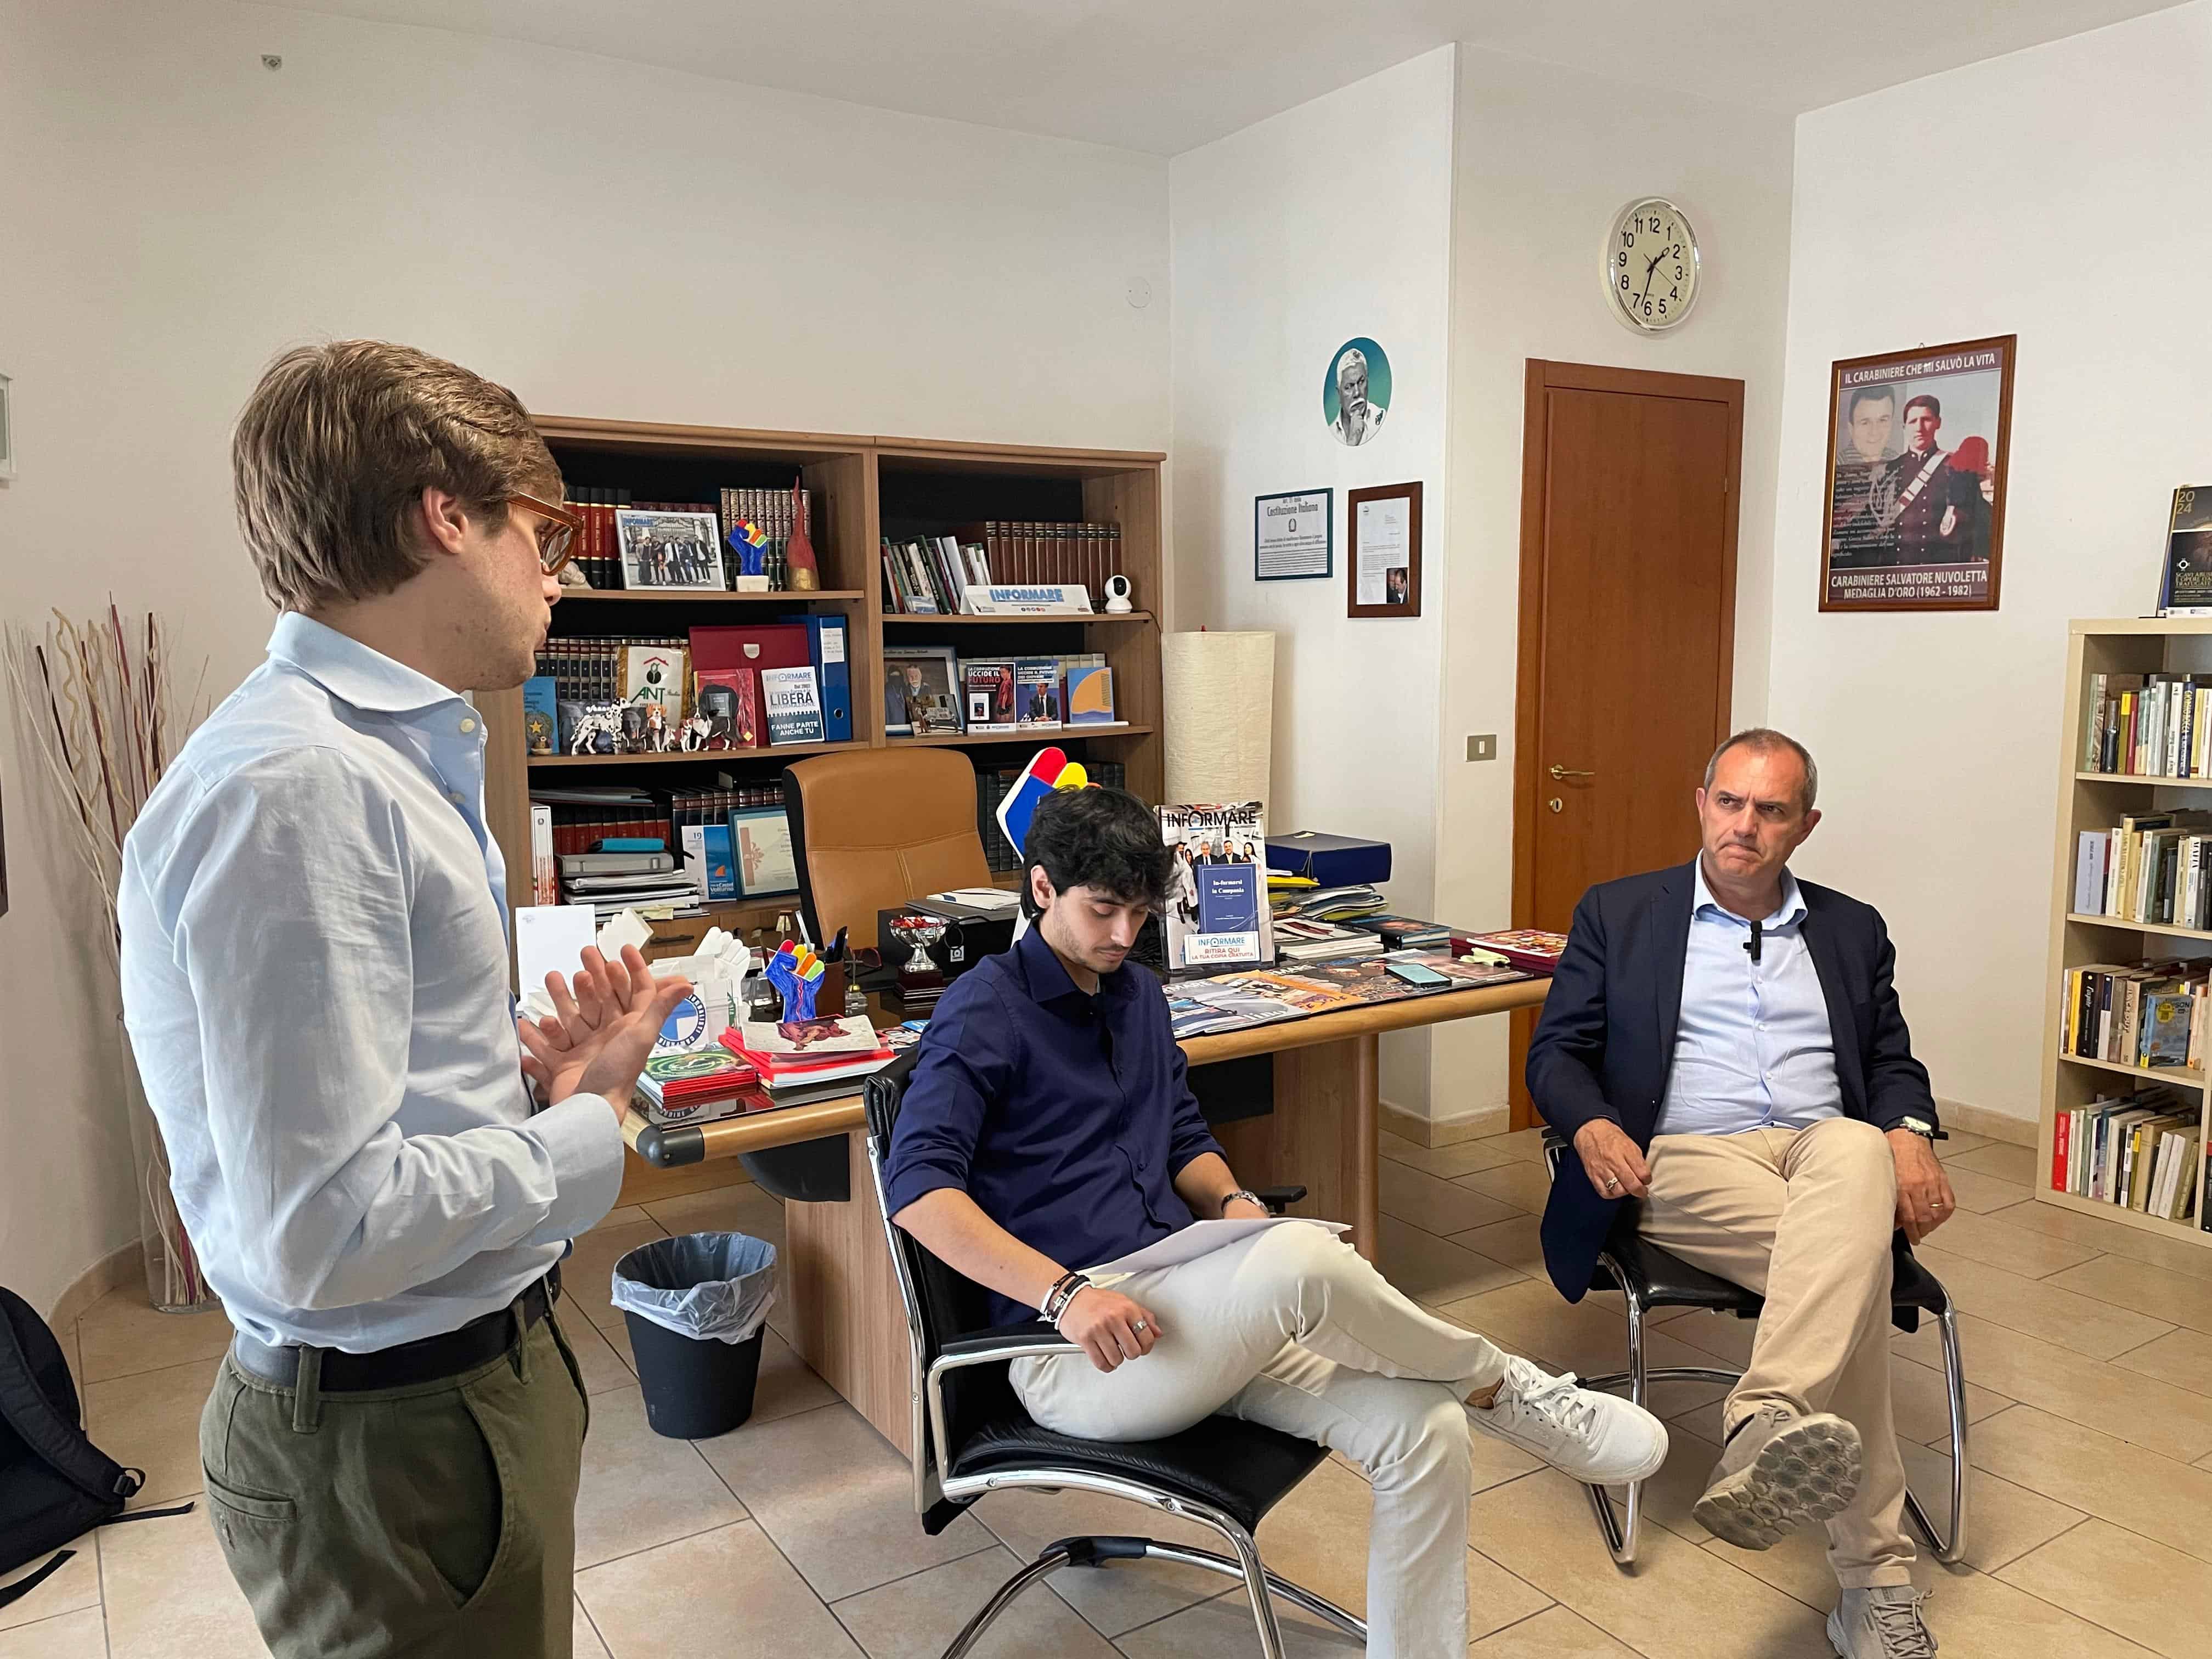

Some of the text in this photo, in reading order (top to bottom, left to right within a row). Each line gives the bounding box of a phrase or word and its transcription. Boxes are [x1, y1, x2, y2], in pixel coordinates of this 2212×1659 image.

[1635, 217, 1671, 241] 11 12 1
[1622, 231, 1680, 259] 10 2
[1618, 251, 1683, 280] 9 3
[1621, 274, 1678, 302] 8 4
[1633, 292, 1667, 316] 7 6 5
[1844, 373, 1853, 384] IL
[1853, 365, 1905, 383] CARABINIERE
[1906, 363, 1922, 376] CHE
[1935, 357, 1963, 372] SALVÒ
[1963, 356, 1975, 368] LA
[1976, 353, 1996, 366] VITA
[2179, 491, 2194, 503] 20
[2177, 503, 2192, 515] 24
[1831, 570, 1988, 588] CARABINIERE SALVATORE NUVOLETTA
[989, 588, 1065, 602] INFORMARE
[1843, 586, 1887, 600] MEDAGLIA
[1888, 586, 1915, 598] D'ORO
[1916, 586, 1940, 599] (1962
[1948, 585, 1972, 597] 1982)
[968, 675, 1001, 684] FUTURO
[630, 687, 665, 705] ANT
[770, 692, 814, 706] LIBERA
[771, 723, 795, 731] FANNE
[1167, 810, 1256, 827] INFORMARE
[1198, 936, 1245, 947] INFORMARE
